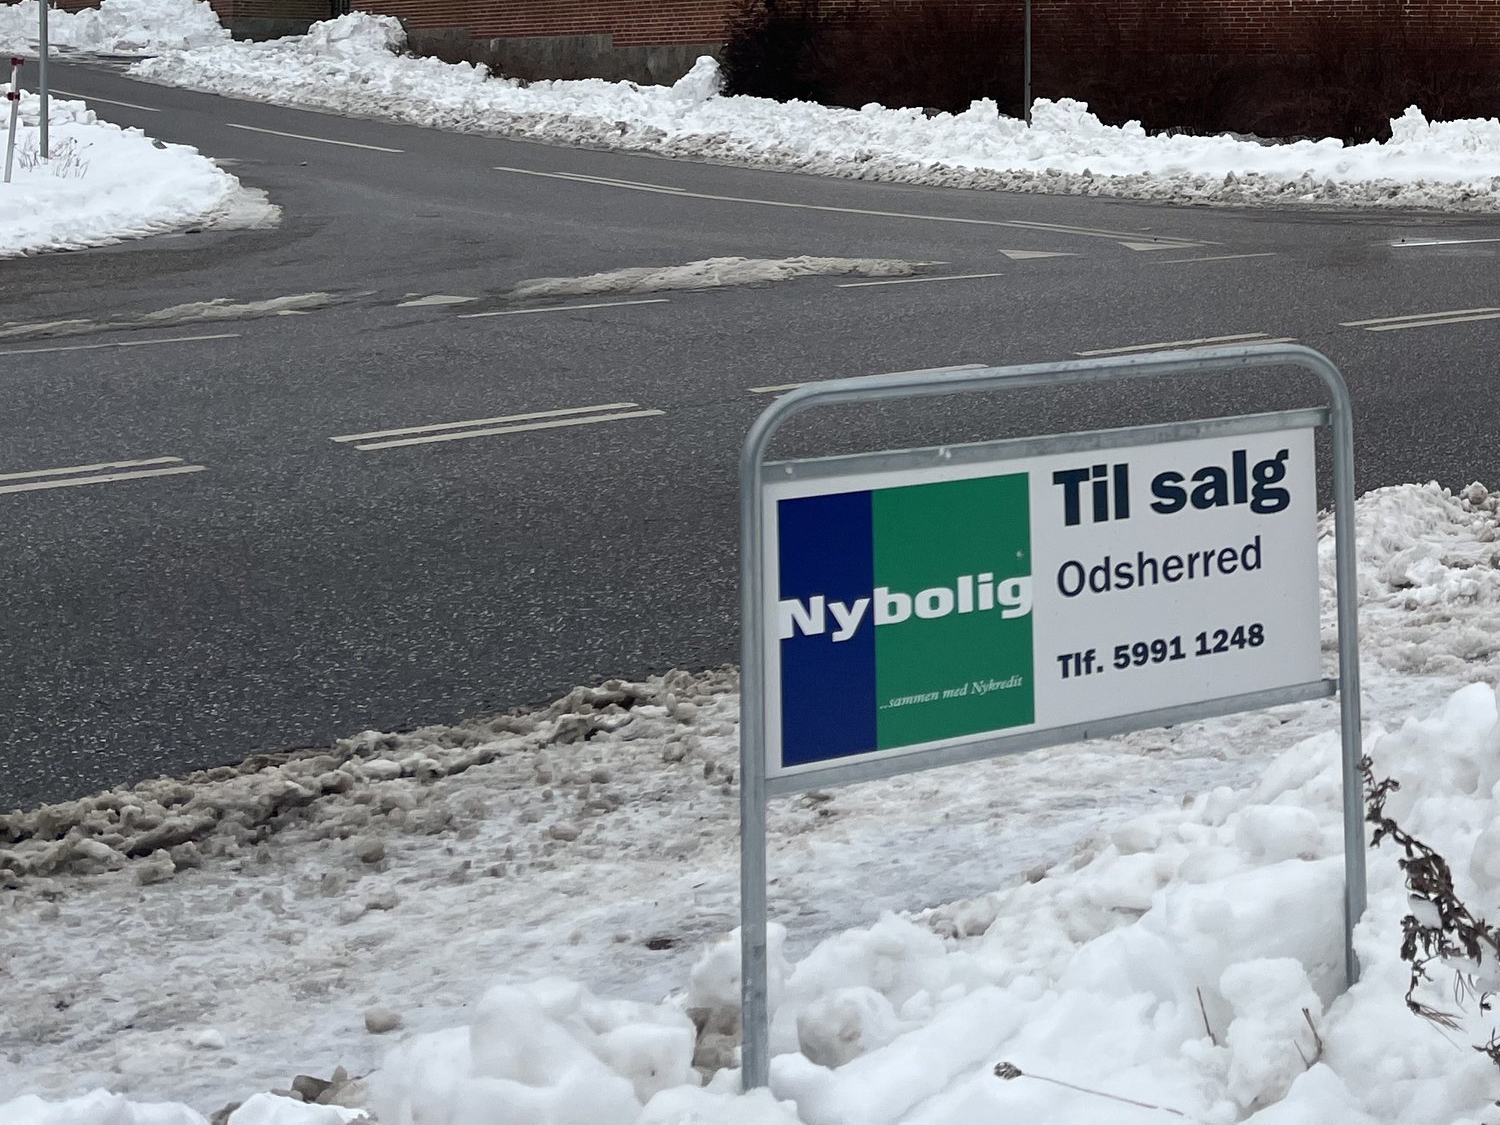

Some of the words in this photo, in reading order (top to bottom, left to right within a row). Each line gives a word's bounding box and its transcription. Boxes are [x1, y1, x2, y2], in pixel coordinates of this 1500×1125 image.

[1052, 462, 1130, 527] Til
[1149, 448, 1291, 515] salg
[1056, 534, 1262, 598] Odsherred
[778, 571, 1034, 643] Nybolig
[1056, 648, 1104, 679] Tlf.
[1112, 635, 1186, 670] 5991
[1194, 622, 1265, 658] 1248
[942, 682, 969, 699] med
[971, 674, 1024, 696] Nykredit
